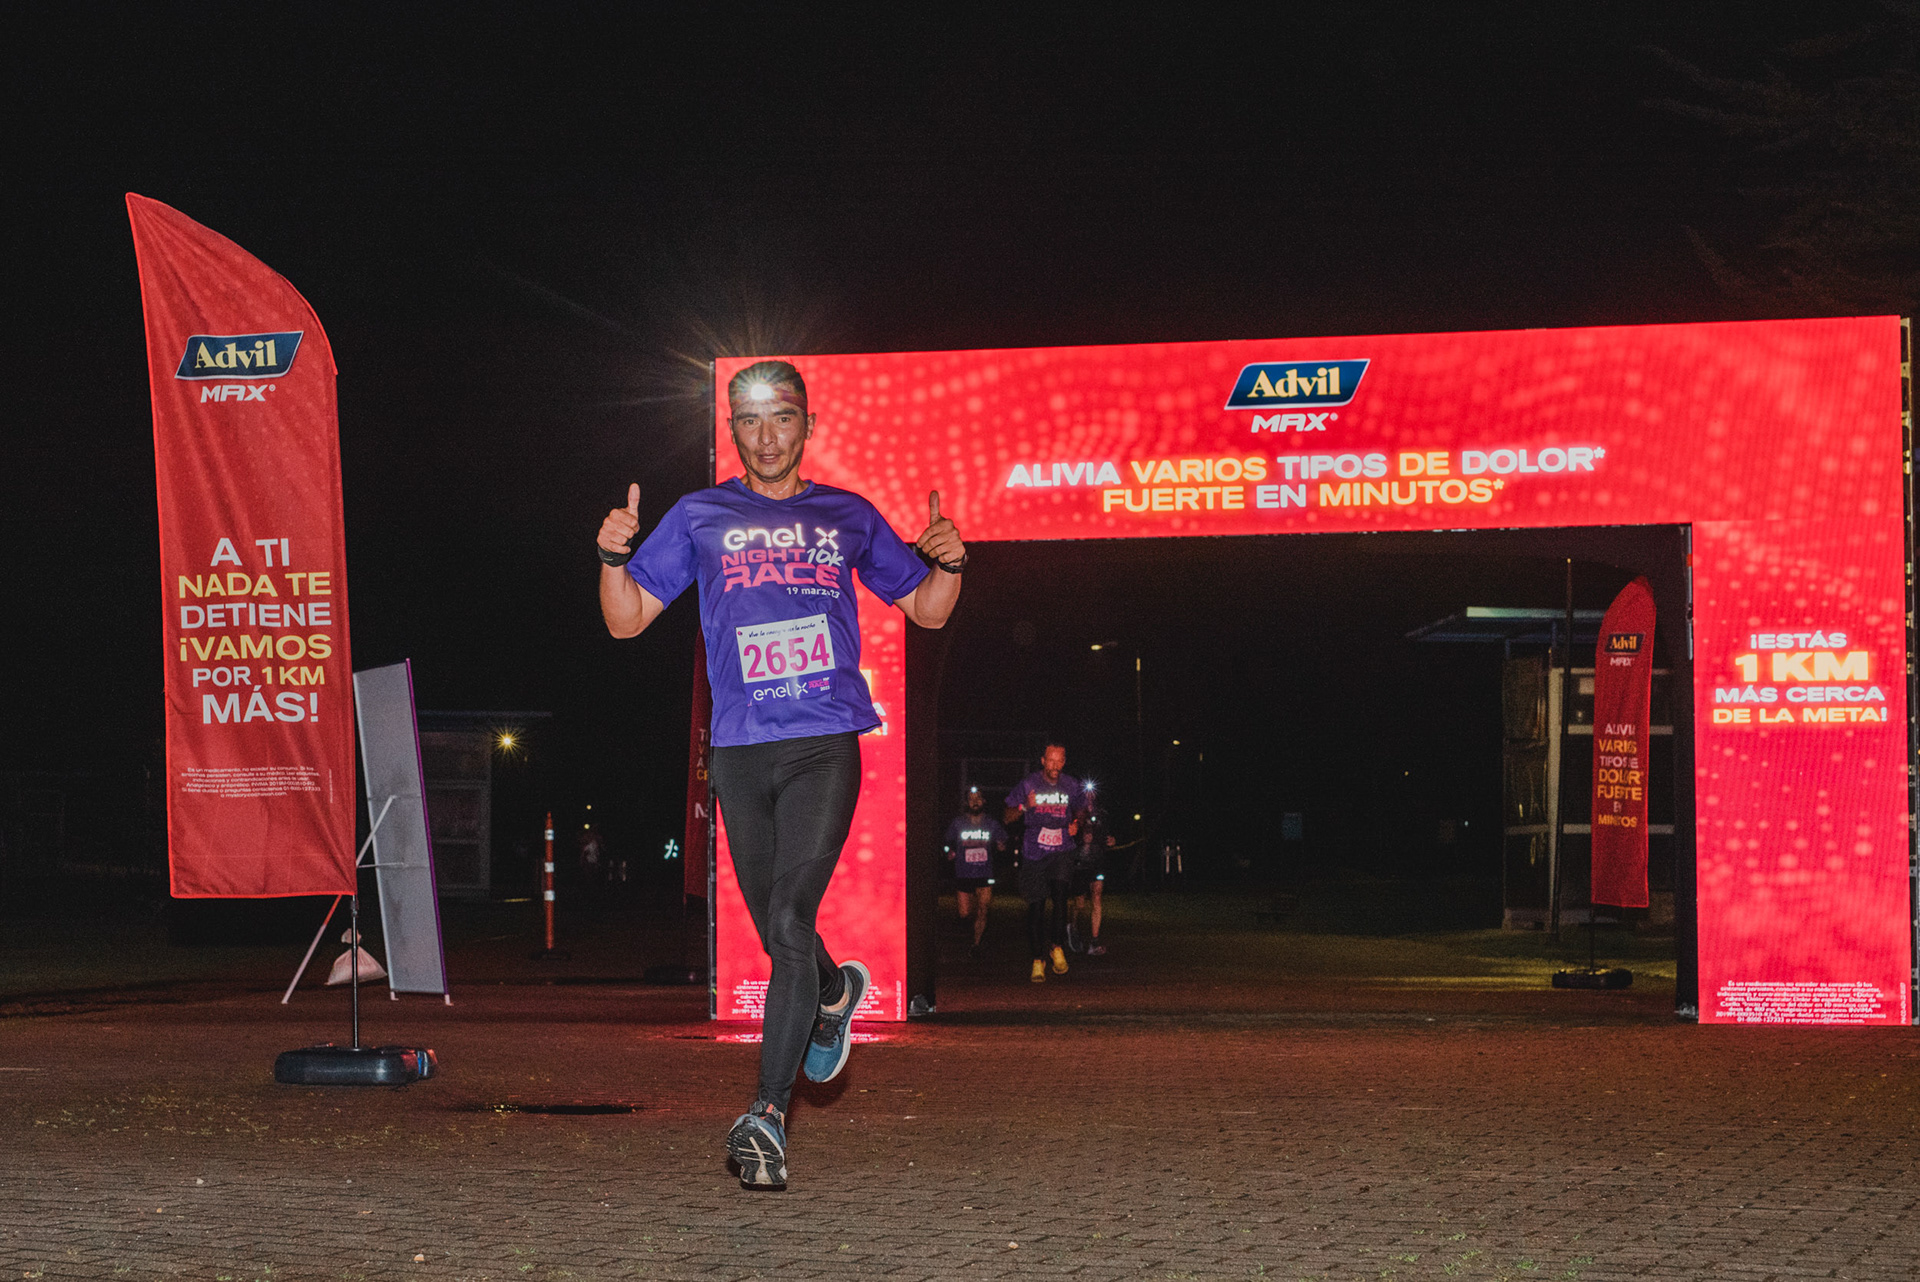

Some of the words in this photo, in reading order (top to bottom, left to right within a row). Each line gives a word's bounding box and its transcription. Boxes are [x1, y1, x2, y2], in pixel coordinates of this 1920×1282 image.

[195, 339, 277, 369] Advil
[1247, 367, 1341, 398] Advil
[1006, 461, 1121, 488] ALIVIA
[1130, 457, 1267, 484] VARIOS
[1276, 453, 1387, 480] TIPOS
[1399, 452, 1450, 477] DE
[1103, 486, 1245, 513] FUERTE
[1256, 484, 1307, 509] EN
[724, 523, 806, 551] enel
[210, 538, 243, 567] A
[255, 538, 290, 567] TI
[721, 548, 806, 569] NIGHT
[178, 572, 278, 599] NADA
[284, 571, 332, 596] TE
[723, 562, 841, 593] RACE
[786, 587, 798, 596] 19
[180, 602, 332, 629] DETIENE
[179, 634, 332, 662] ¡VAMOS
[1610, 635, 1637, 650] Advil
[1750, 630, 1847, 649] ¡ESTÁS
[743, 633, 830, 679] 2654
[1735, 654, 1758, 682] 1
[1772, 651, 1869, 682] KM
[192, 666, 252, 688] POR
[261, 666, 273, 685] 1
[279, 665, 326, 686] KM
[202, 685, 319, 724] MÁS!
[753, 682, 792, 701] enel
[1715, 684, 1778, 703] MÁS
[1786, 686, 1886, 702] CERCA
[1713, 708, 1751, 724] DE
[1759, 708, 1795, 723] LA
[1803, 707, 1888, 723] META!
